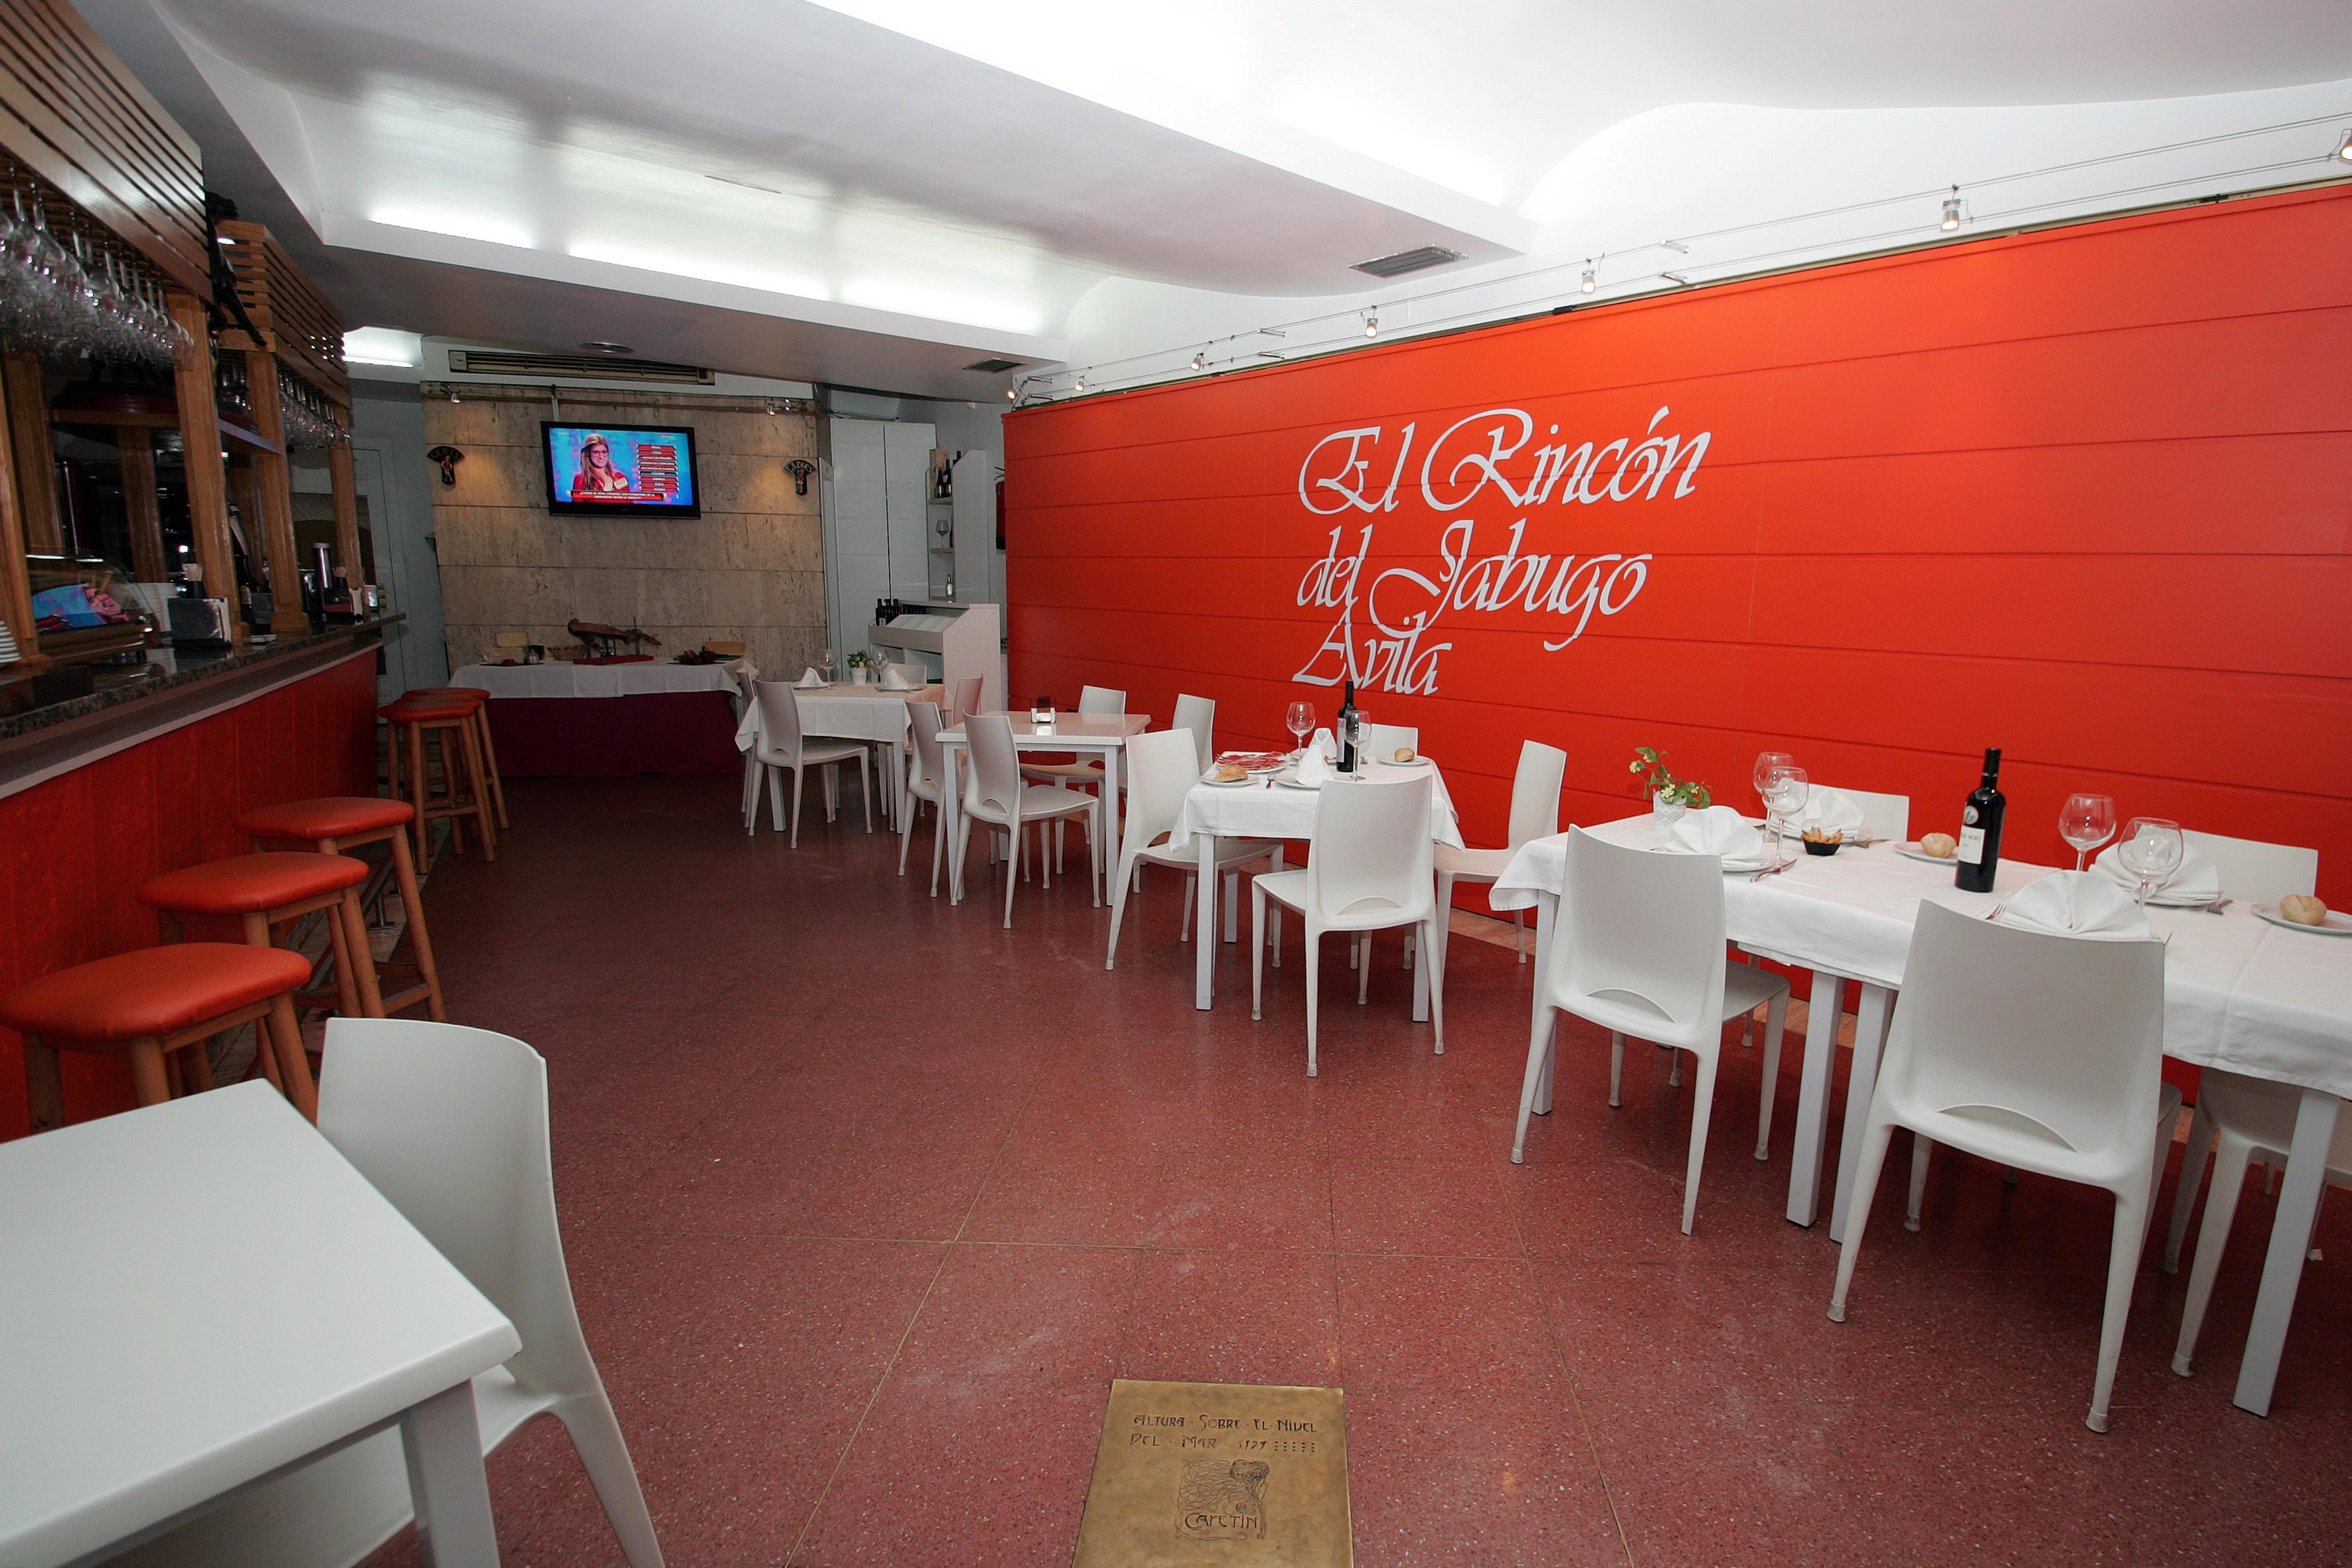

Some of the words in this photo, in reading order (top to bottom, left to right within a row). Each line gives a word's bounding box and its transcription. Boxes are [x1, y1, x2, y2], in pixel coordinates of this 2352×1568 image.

[785, 461, 813, 474] LADIES
[1298, 422, 1415, 514] El
[1421, 406, 1711, 512] Rincón
[1296, 523, 1373, 607] del
[1369, 518, 1653, 652] Jabugo
[1133, 1414, 1185, 1427] ALTURA
[1199, 1414, 1241, 1431] SOBRE
[1253, 1418, 1269, 1431] EL
[1129, 1433, 1160, 1447] DEL
[1182, 1435, 1217, 1449] MAR
